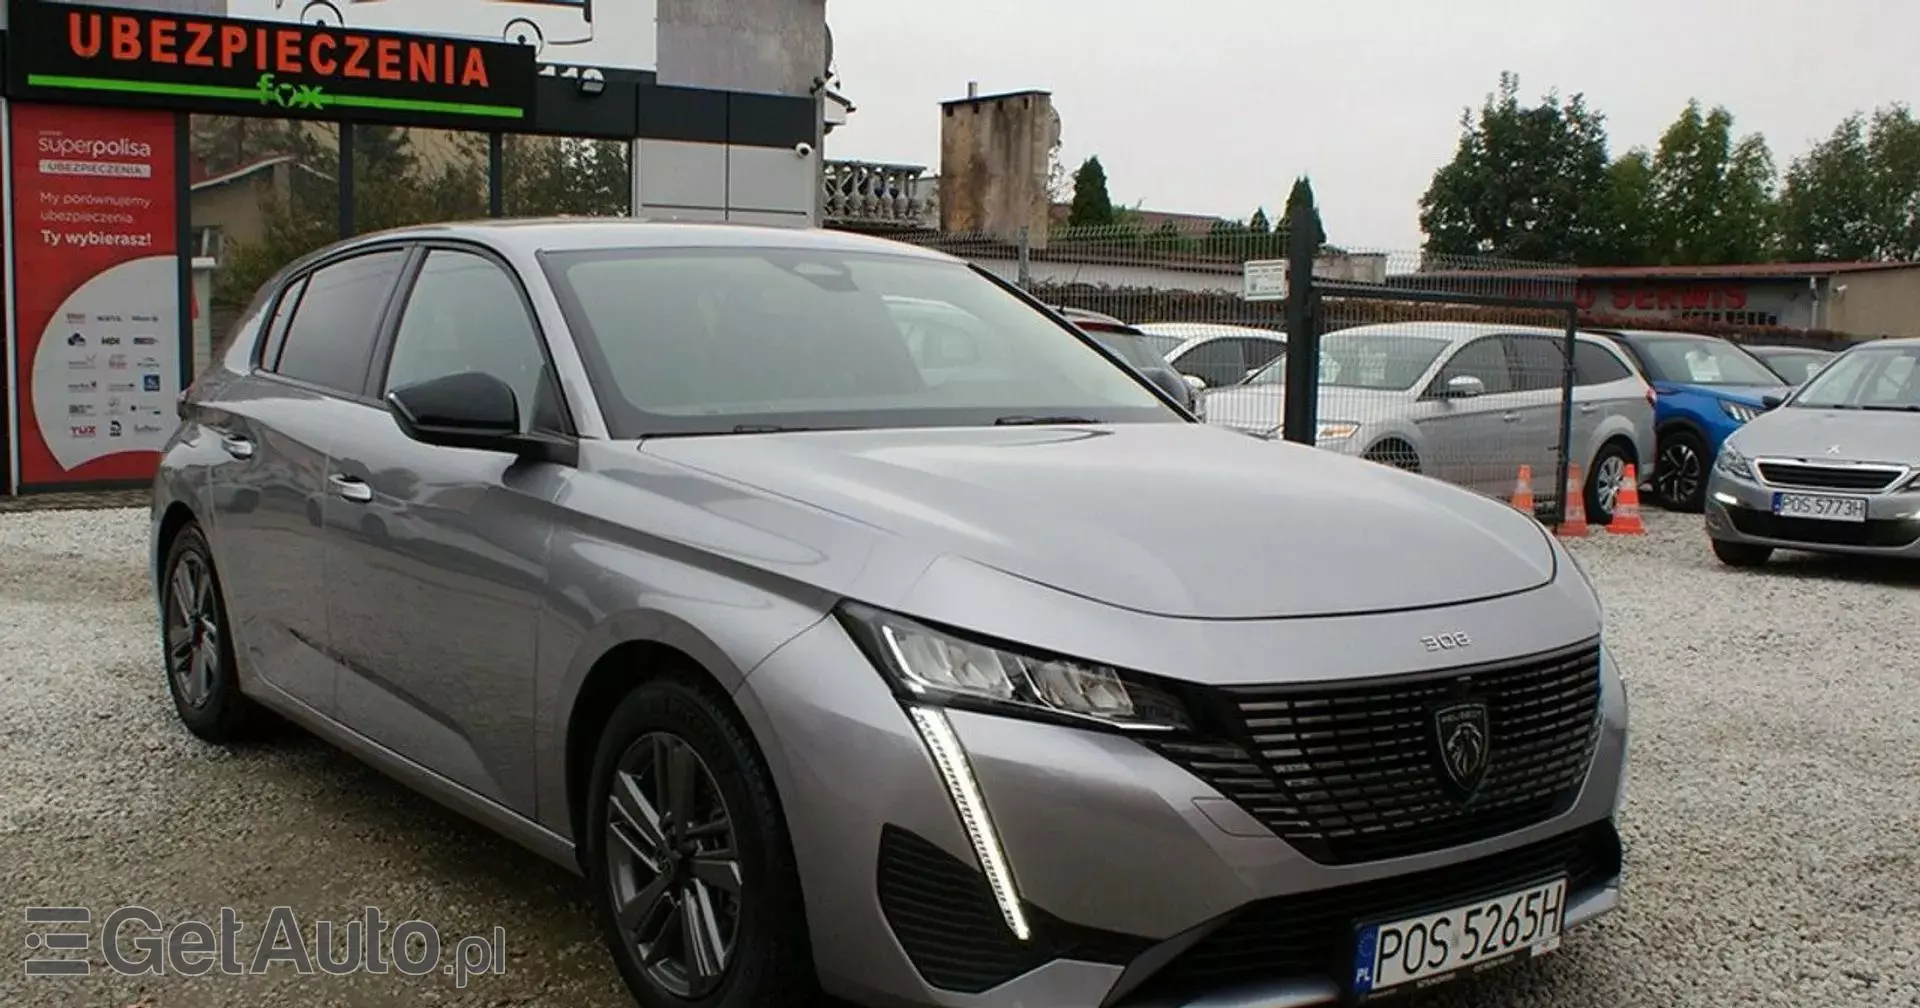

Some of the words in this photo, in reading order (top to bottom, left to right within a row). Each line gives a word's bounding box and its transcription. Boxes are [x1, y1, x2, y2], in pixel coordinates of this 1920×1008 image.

[68, 12, 489, 88] UBEZPIECZENIA
[38, 137, 151, 158] superpolisa
[47, 162, 142, 174] UBEZPIECZENIA
[40, 191, 59, 206] My
[41, 229, 61, 246] Ty
[65, 232, 152, 247] wybierasz!
[1783, 496, 1811, 513] POS
[1815, 499, 1864, 516] 5773H
[1420, 632, 1470, 652] 308
[1375, 917, 1452, 983] POS
[1460, 884, 1563, 960] 5265H
[1355, 967, 1371, 983] PL
